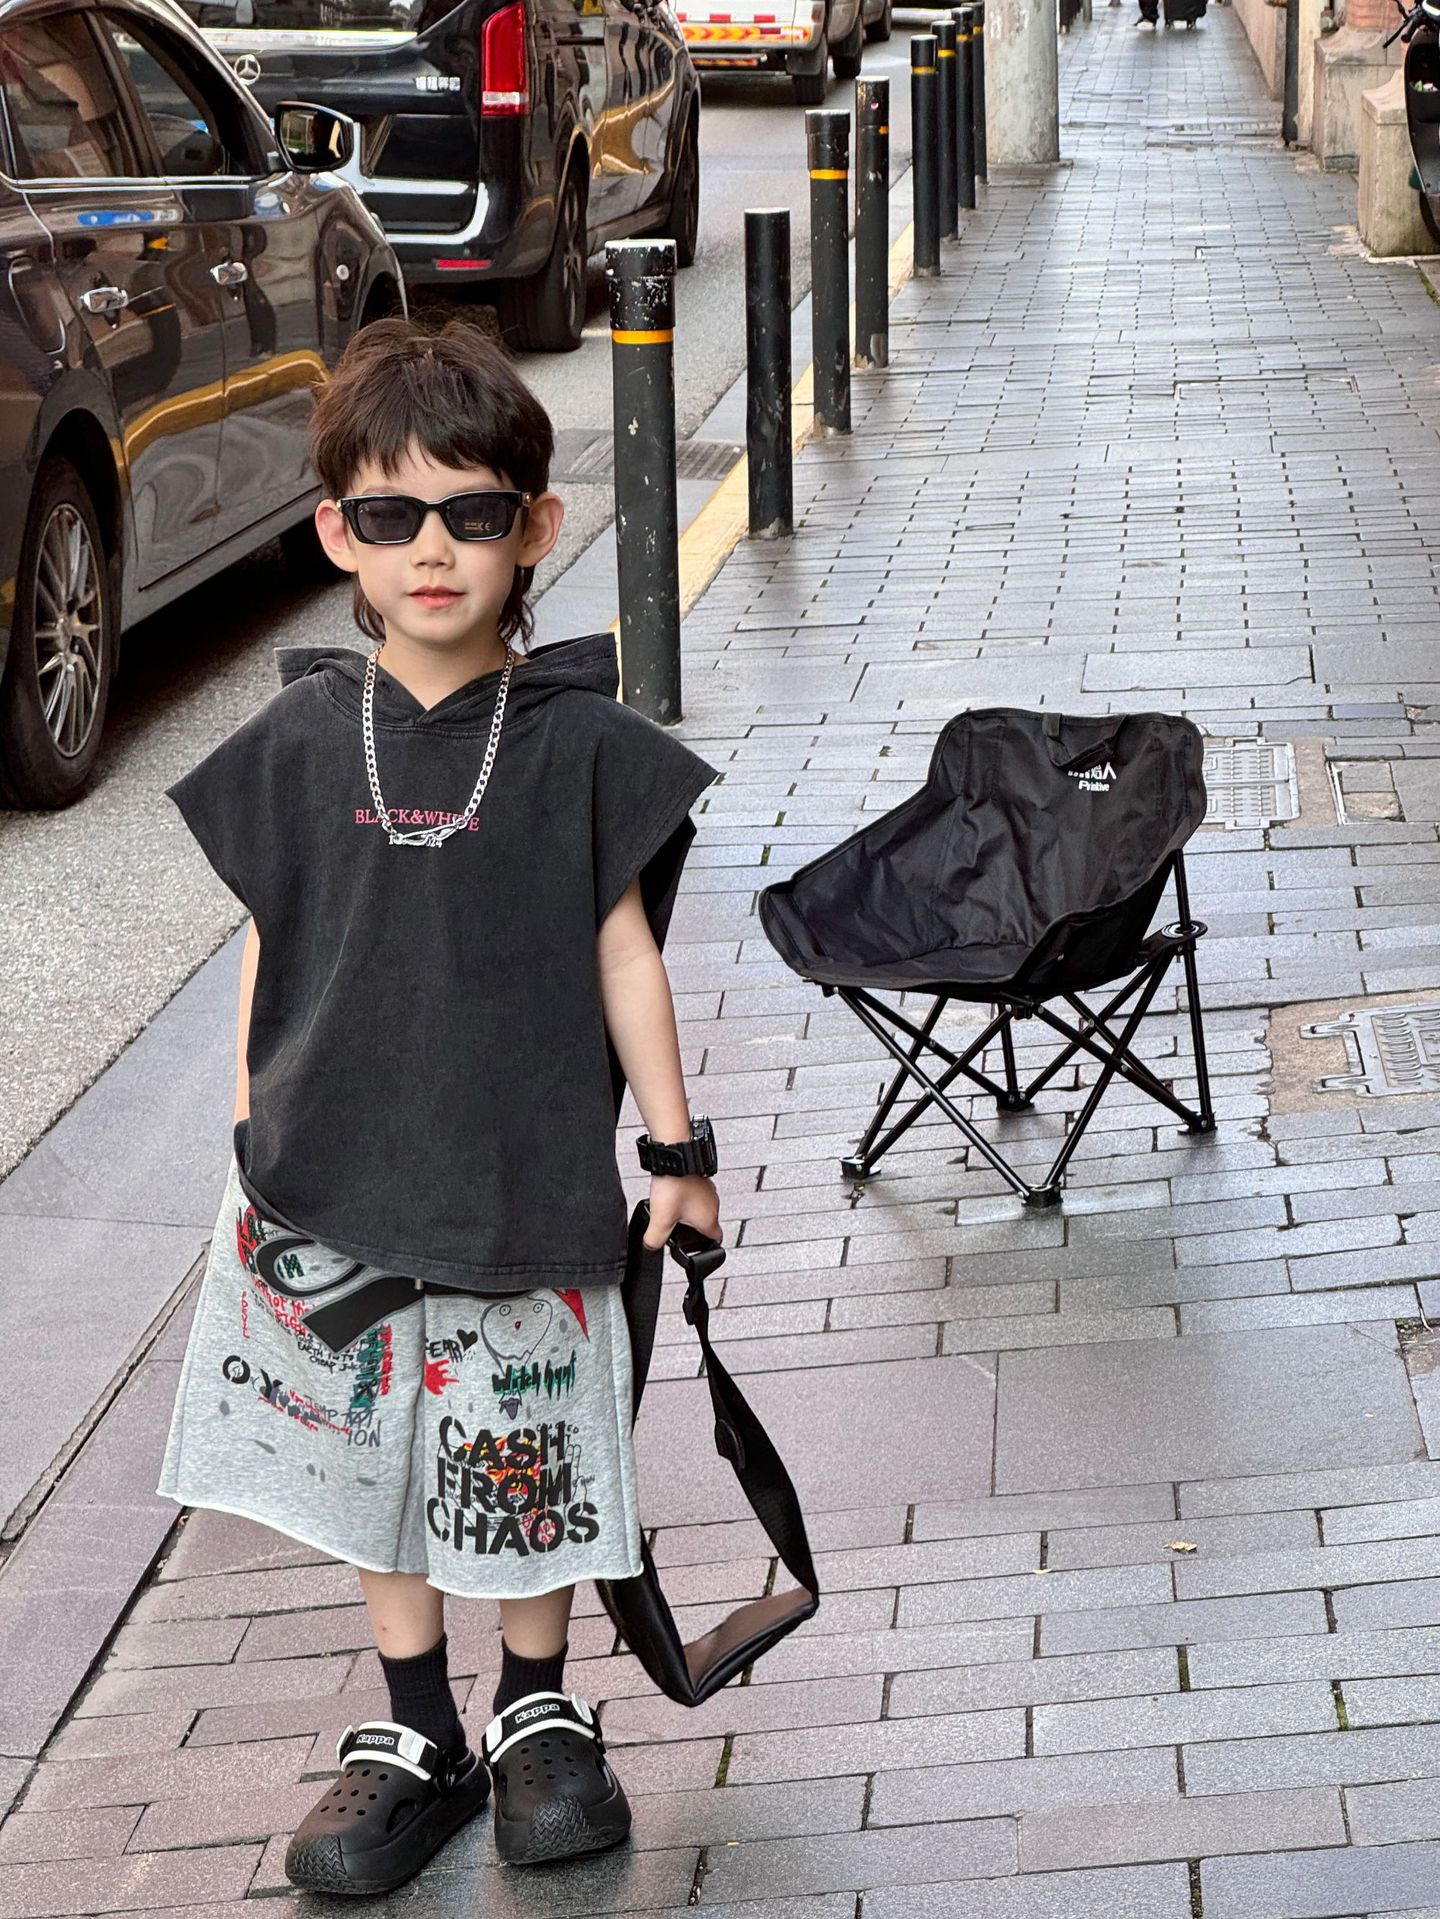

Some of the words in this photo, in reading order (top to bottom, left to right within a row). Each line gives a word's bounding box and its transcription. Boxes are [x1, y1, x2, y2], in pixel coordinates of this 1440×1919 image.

[439, 1415, 566, 1470] CASH
[437, 1457, 572, 1514] FROM
[426, 1497, 600, 1557] CHAOS
[356, 1733, 395, 1746] Kappa
[515, 1703, 561, 1723] Kappa
